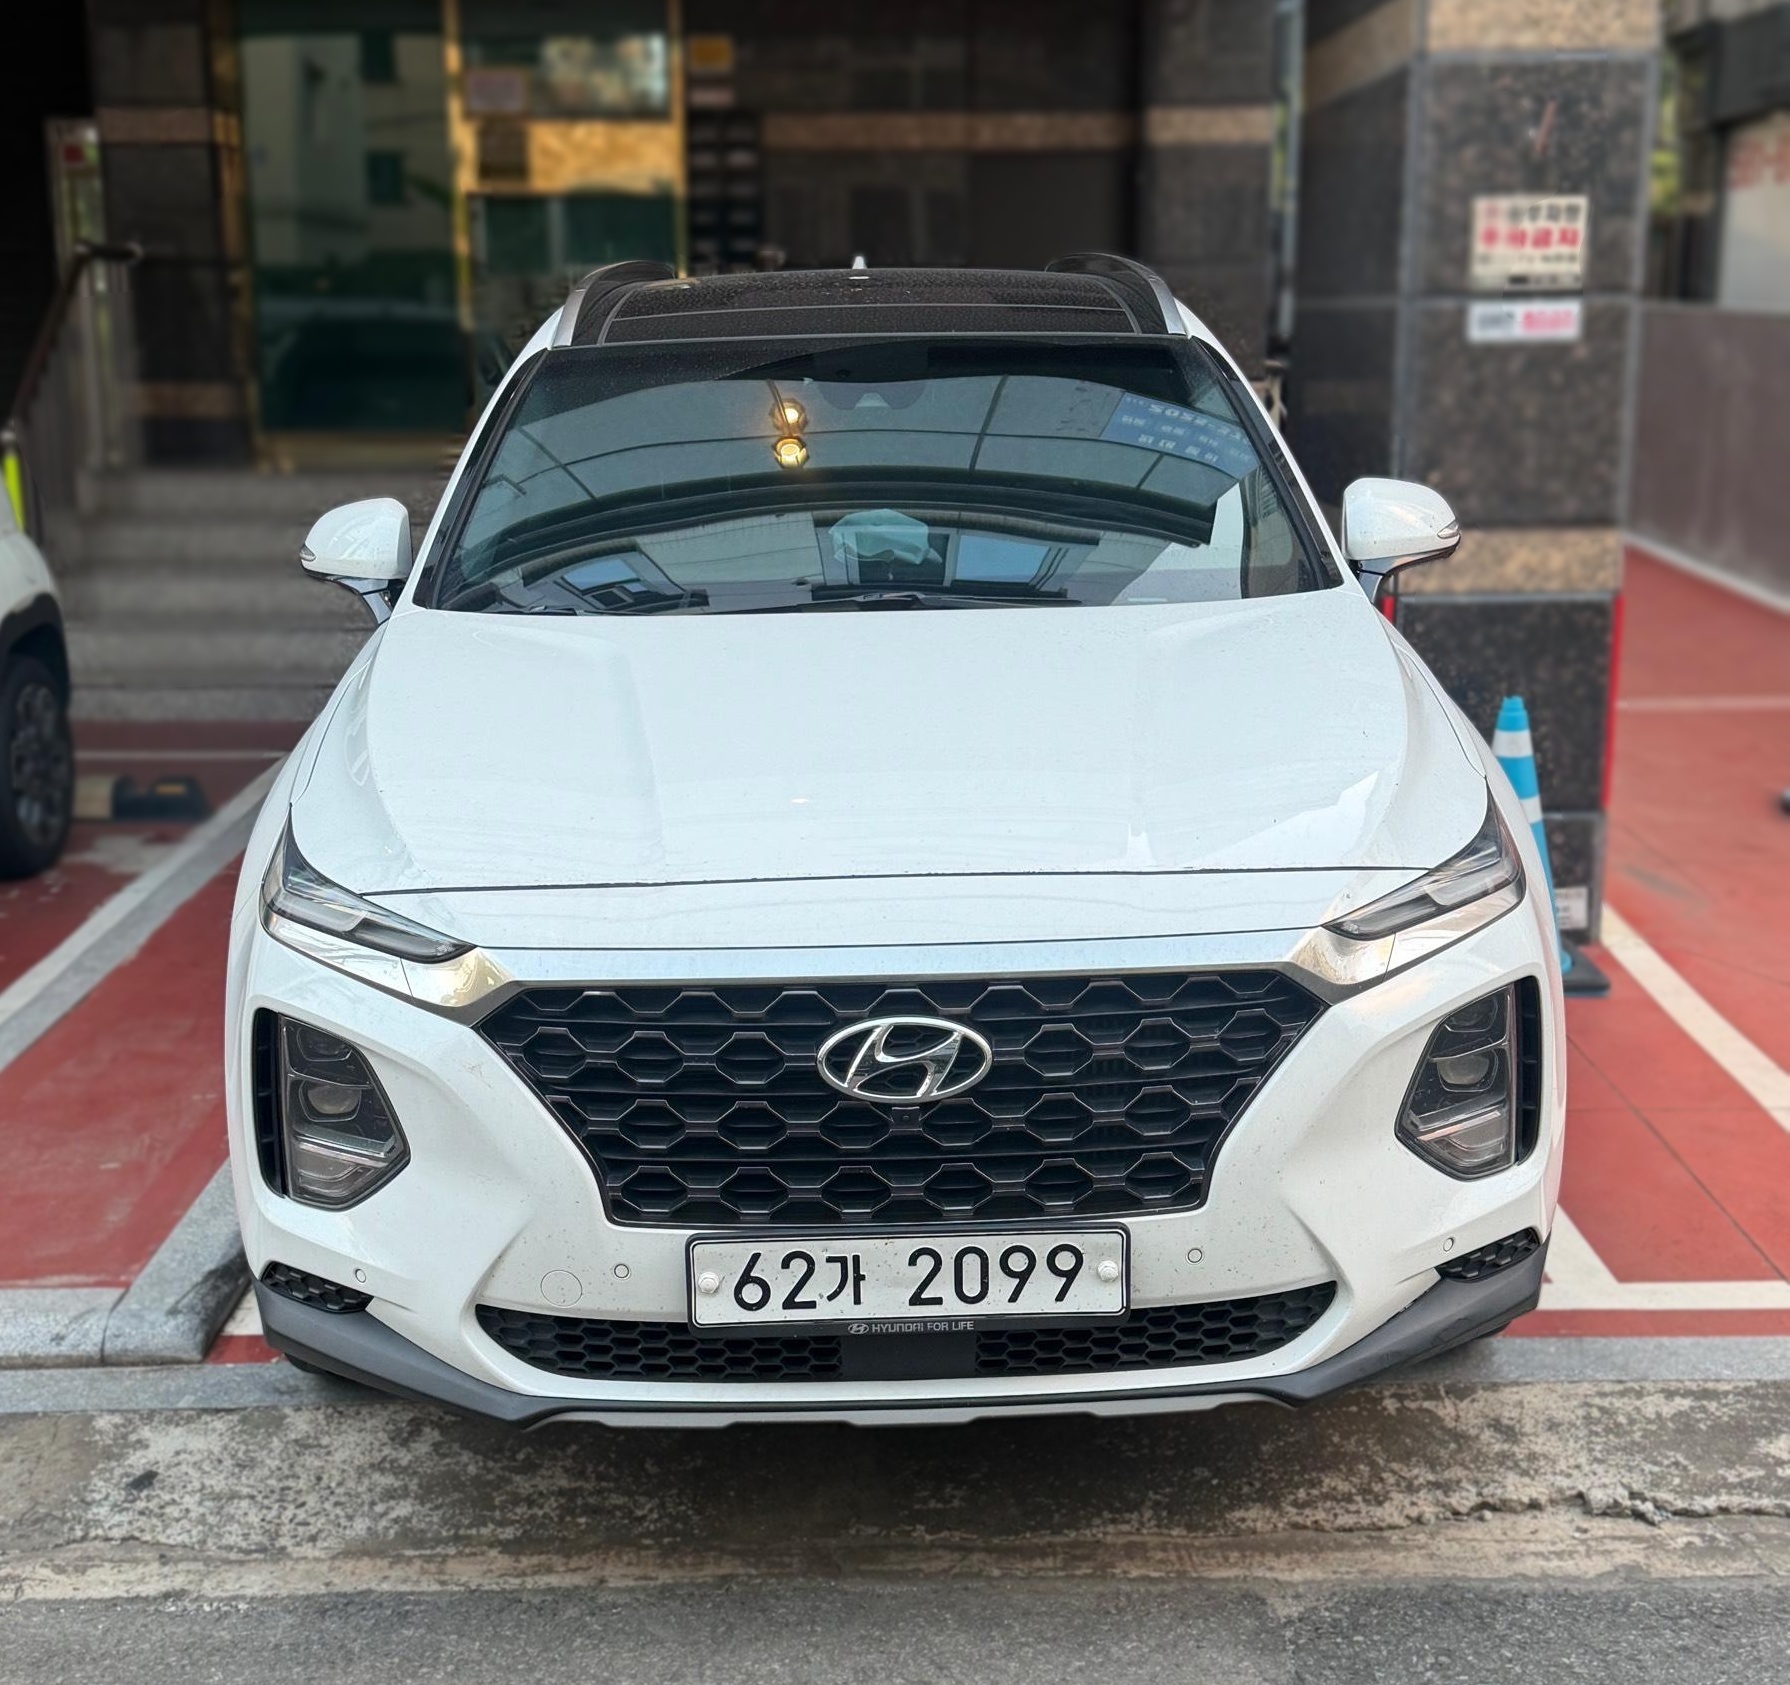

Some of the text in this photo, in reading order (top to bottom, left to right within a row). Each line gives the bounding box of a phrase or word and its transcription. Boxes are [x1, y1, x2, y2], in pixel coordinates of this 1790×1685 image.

[733, 1243, 1084, 1312] 62가 2099
[871, 1320, 975, 1333] HYUNDAI FOR LIFE
